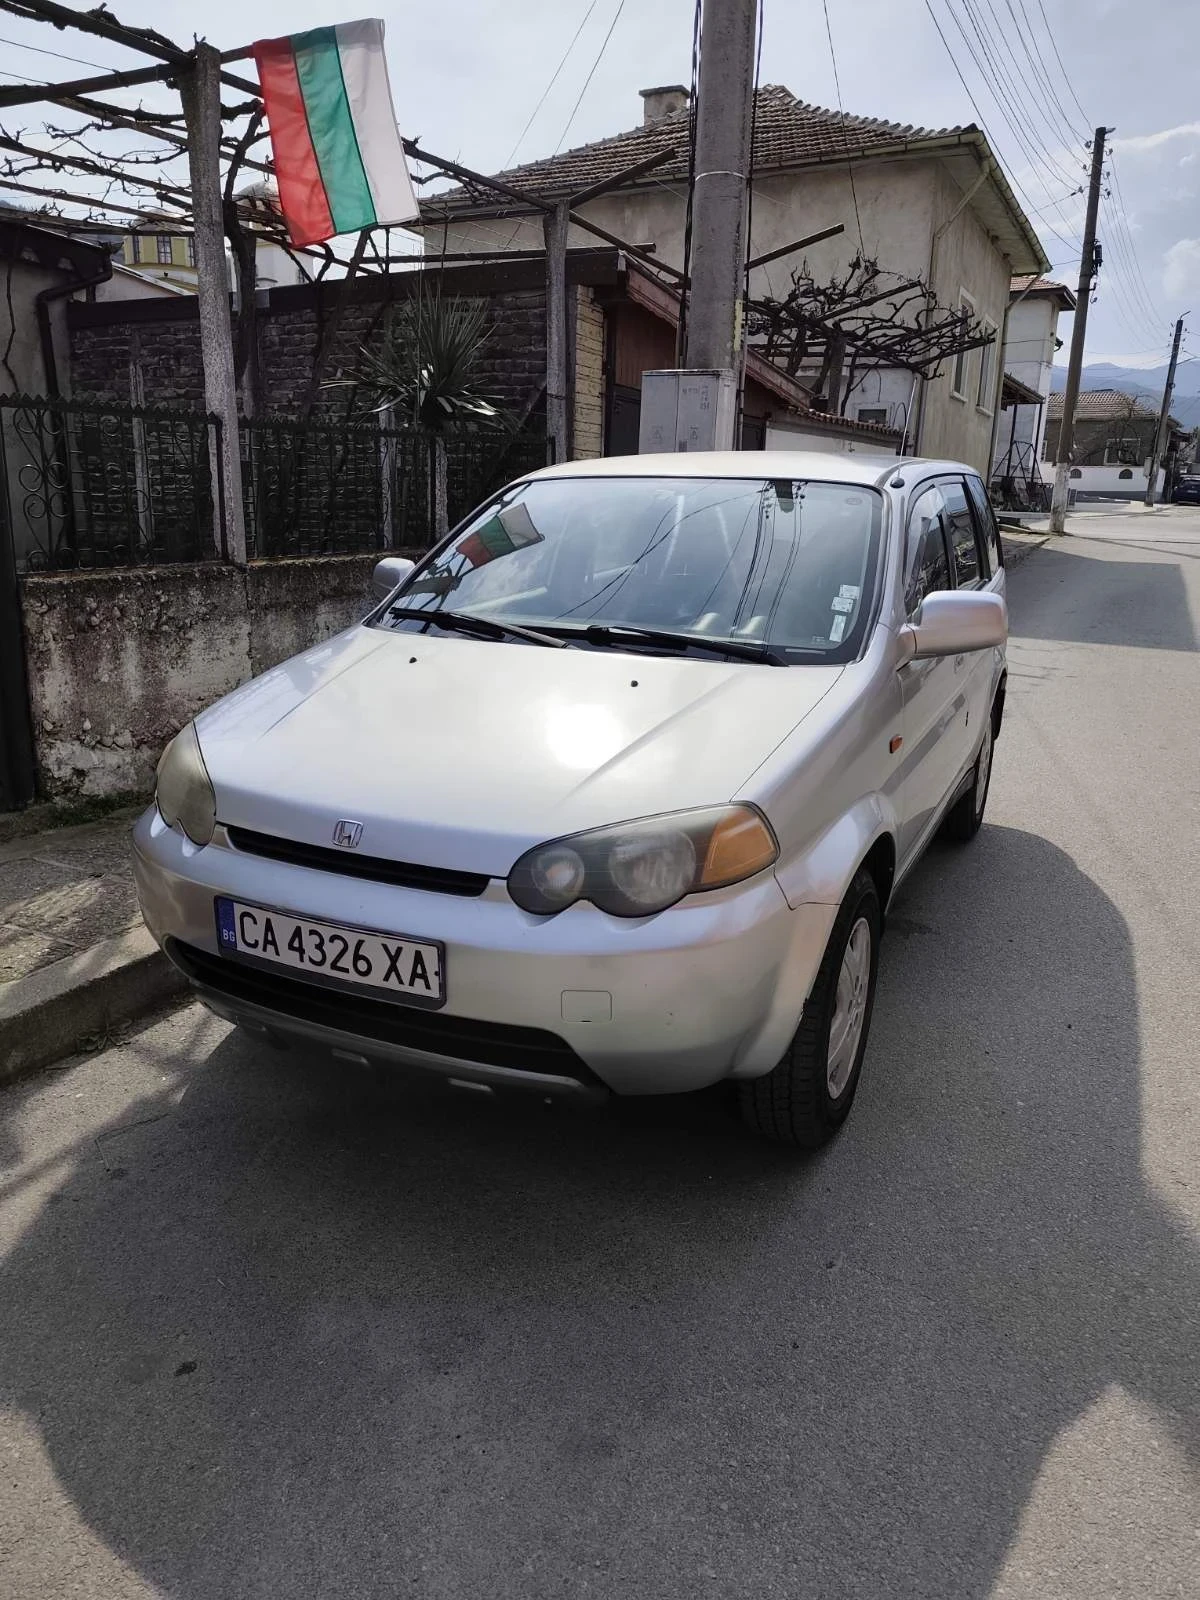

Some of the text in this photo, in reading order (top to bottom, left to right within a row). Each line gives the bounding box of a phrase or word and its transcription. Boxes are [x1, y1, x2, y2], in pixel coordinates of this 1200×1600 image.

[222, 928, 236, 942] BG
[239, 911, 432, 990] CA 4326 XA
